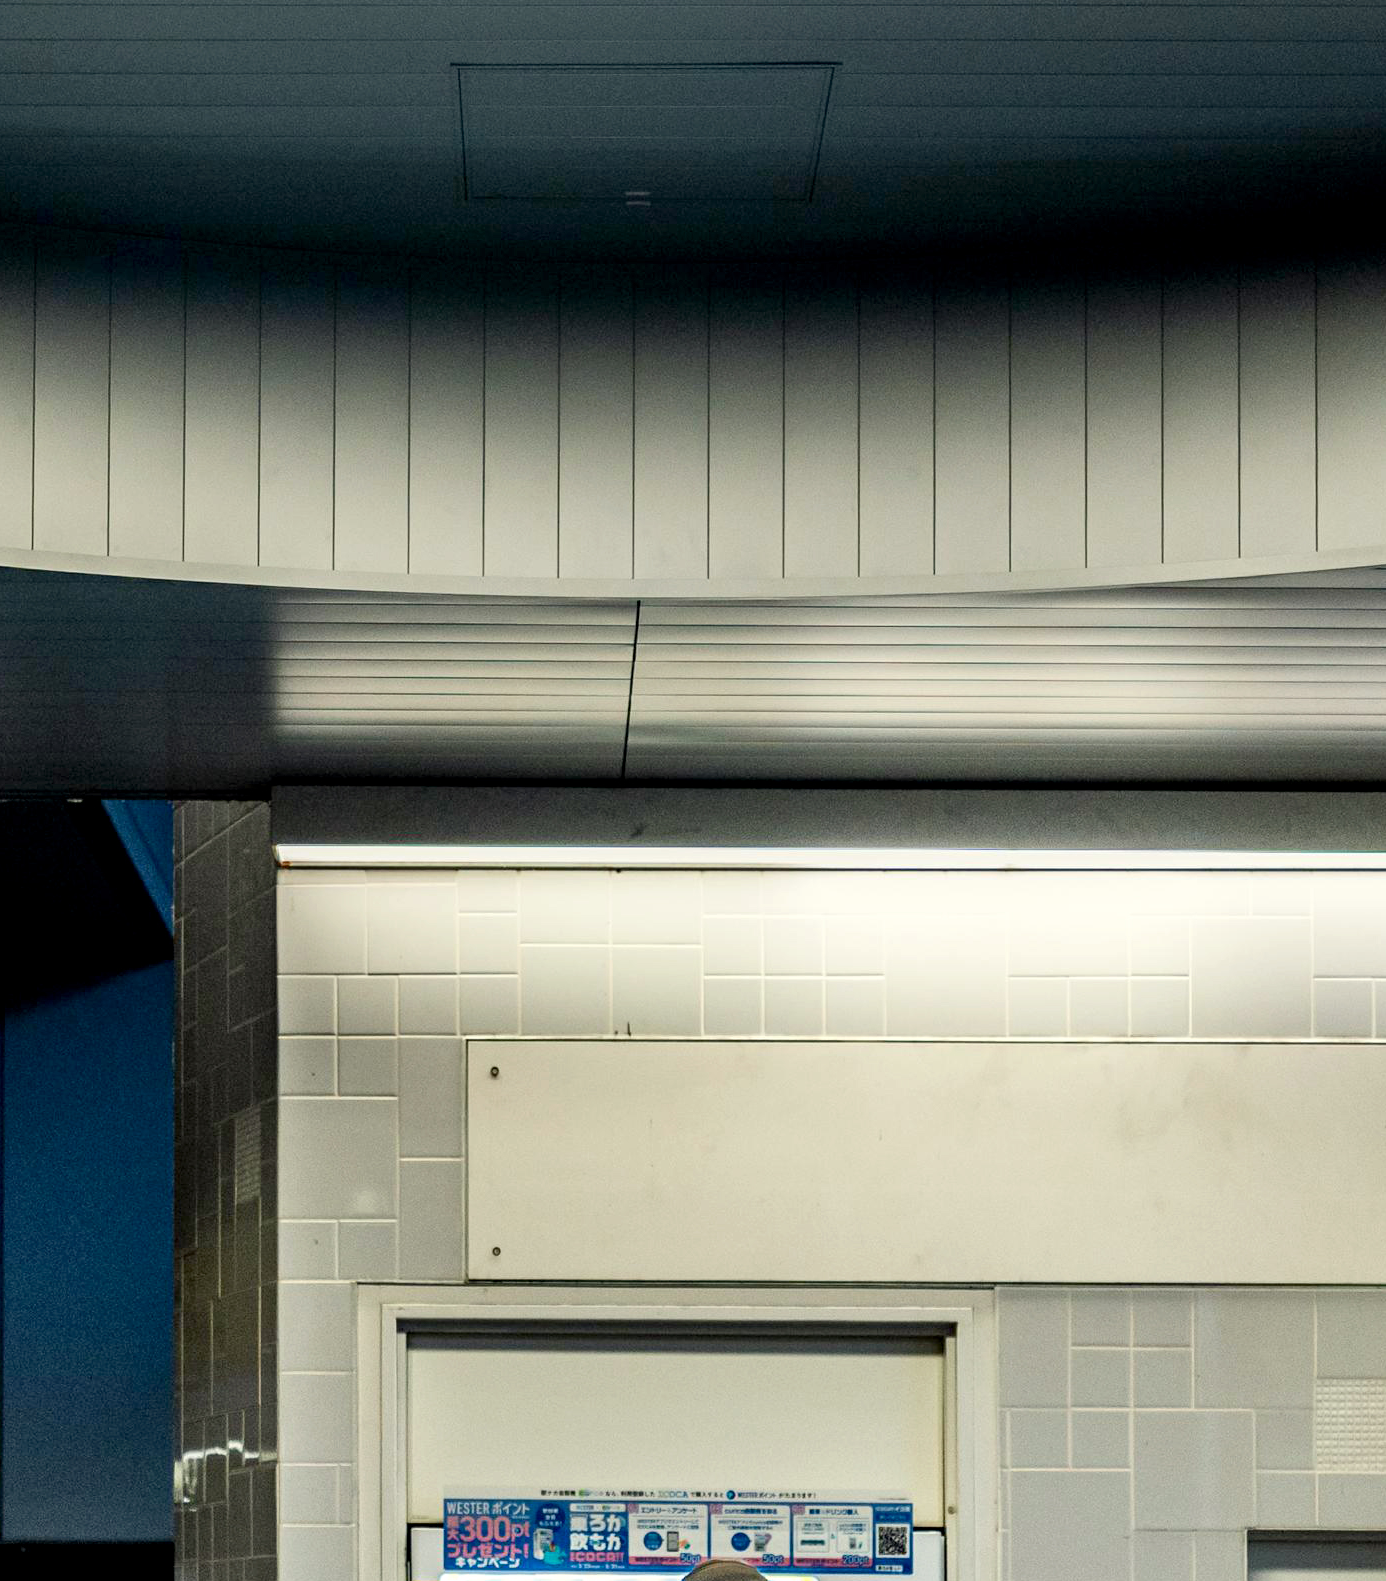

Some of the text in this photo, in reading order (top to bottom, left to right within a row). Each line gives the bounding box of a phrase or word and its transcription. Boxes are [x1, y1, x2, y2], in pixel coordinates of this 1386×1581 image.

[446, 1502, 490, 1515] WESTER
[492, 1501, 530, 1515] ポイント
[459, 1515, 530, 1543] 300pt
[455, 1557, 521, 1568] キャンペーン
